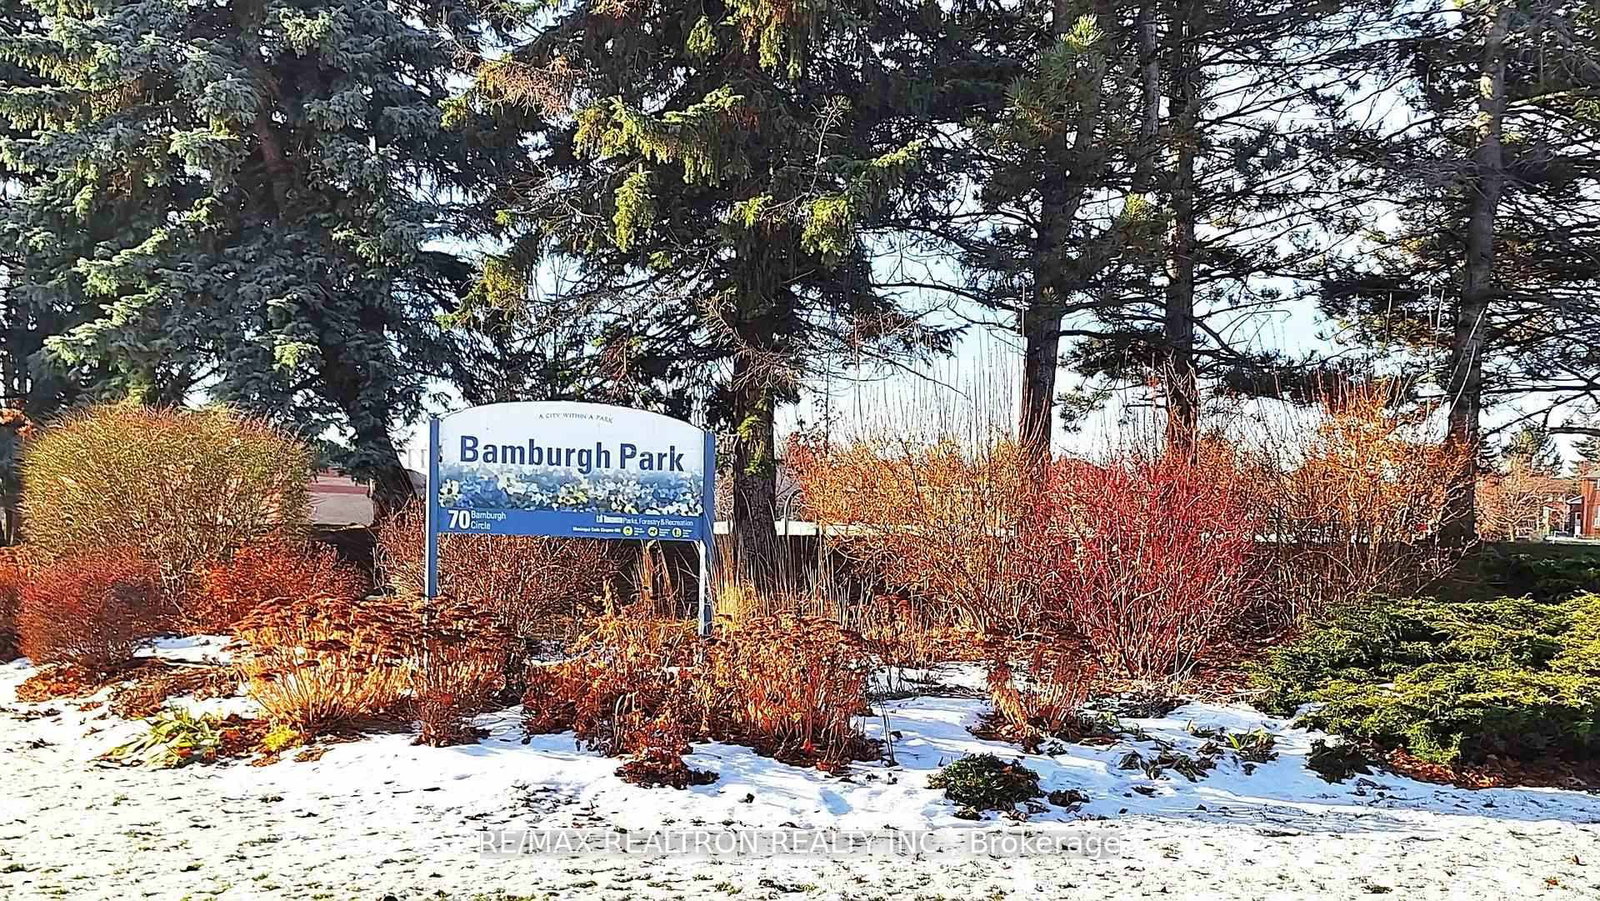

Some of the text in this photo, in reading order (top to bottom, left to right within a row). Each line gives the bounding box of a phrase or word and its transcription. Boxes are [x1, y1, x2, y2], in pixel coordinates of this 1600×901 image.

[596, 415, 613, 423] PARK
[460, 435, 685, 474] Bamburgh Park
[447, 509, 471, 529] 70
[471, 510, 507, 521] Bamburgh
[470, 520, 491, 530] Circle
[665, 519, 694, 527] Recreation
